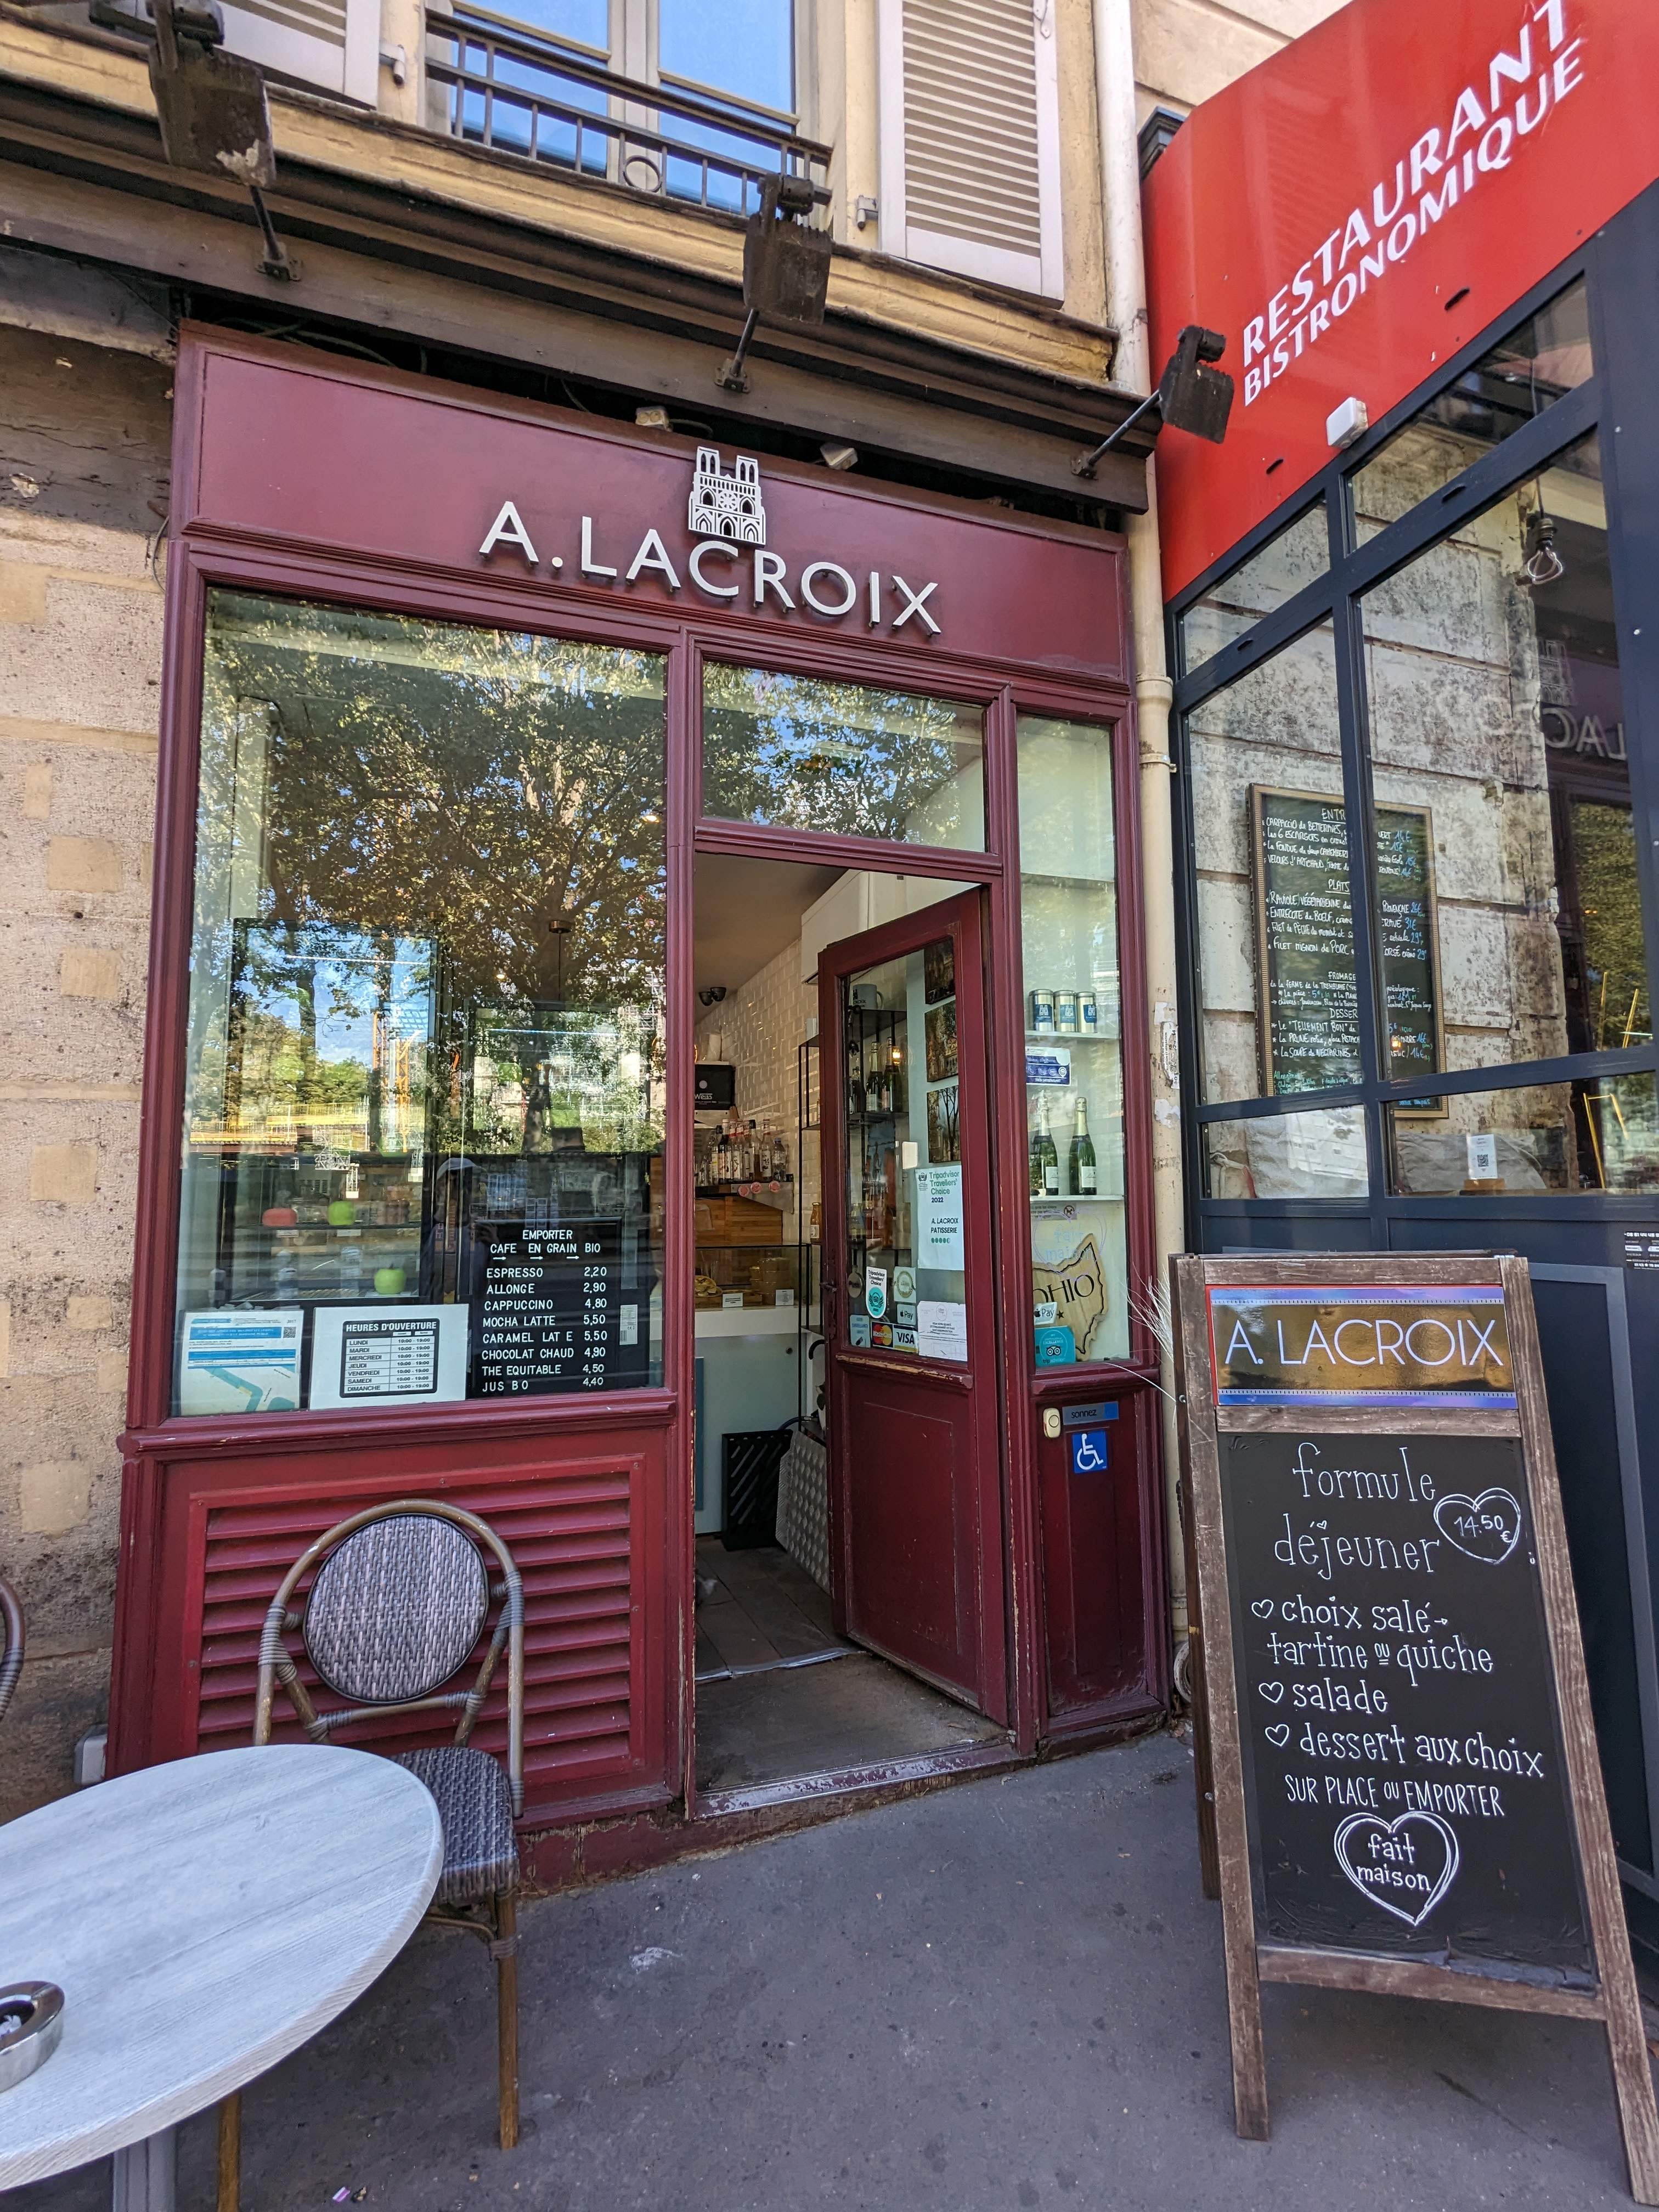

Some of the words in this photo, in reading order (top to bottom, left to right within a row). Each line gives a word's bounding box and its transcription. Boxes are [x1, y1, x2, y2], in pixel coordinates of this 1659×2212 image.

[1243, 0, 1567, 367] RESTAURANT
[1244, 37, 1585, 407] BISTRONOMIQUE
[1278, 828, 1283, 838] 6
[1328, 879, 1350, 892] PLATS
[929, 1171, 959, 1180] Tripadvisor
[523, 1230, 573, 1240] EMPORTER
[490, 1243, 516, 1254] CAFE
[528, 1243, 541, 1253] EN
[546, 1243, 577, 1253] GRAIN
[585, 1243, 600, 1252] BIO
[487, 1268, 543, 1278] ESPRESSO
[487, 1283, 535, 1294] ALLONGE
[484, 1300, 553, 1311] CAPPUCCINO
[904, 1311, 913, 1320] Pay
[1042, 1308, 1054, 1318] Pay
[381, 1322, 436, 1330] D'OUVERTURE
[483, 1317, 518, 1327] MOCHA
[523, 1316, 555, 1326] LATTE
[483, 1332, 534, 1344] CARAMEL
[896, 1331, 915, 1344] VISA
[1225, 1319, 1263, 1364] A.
[1277, 1319, 1503, 1366] LACROIX
[482, 1348, 534, 1360] CHOCOLAT
[540, 1348, 574, 1358] CHAUD
[482, 1365, 502, 1376] THE
[506, 1364, 561, 1375] EQUITABLE
[482, 1381, 504, 1392] JUS
[1071, 1409, 1097, 1418] sonnez
[1293, 1442, 1436, 1502] formule
[1274, 1513, 1440, 1579] déjeuner
[1282, 1594, 1362, 1629] choix
[1372, 1599, 1431, 1633] salé
[1267, 1632, 1368, 1669] tartine
[1397, 1635, 1493, 1686] quiche
[1293, 1678, 1388, 1714] salade
[1300, 1723, 1405, 1763] dessert
[1415, 1735, 1461, 1765] aux
[1466, 1733, 1544, 1778] choix
[1284, 1774, 1318, 1804] SUR
[1325, 1775, 1379, 1807] PLACE
[1404, 1781, 1505, 1816] EMPORTER
[1368, 1833, 1415, 1864] fait
[1356, 1864, 1431, 1891] maison
